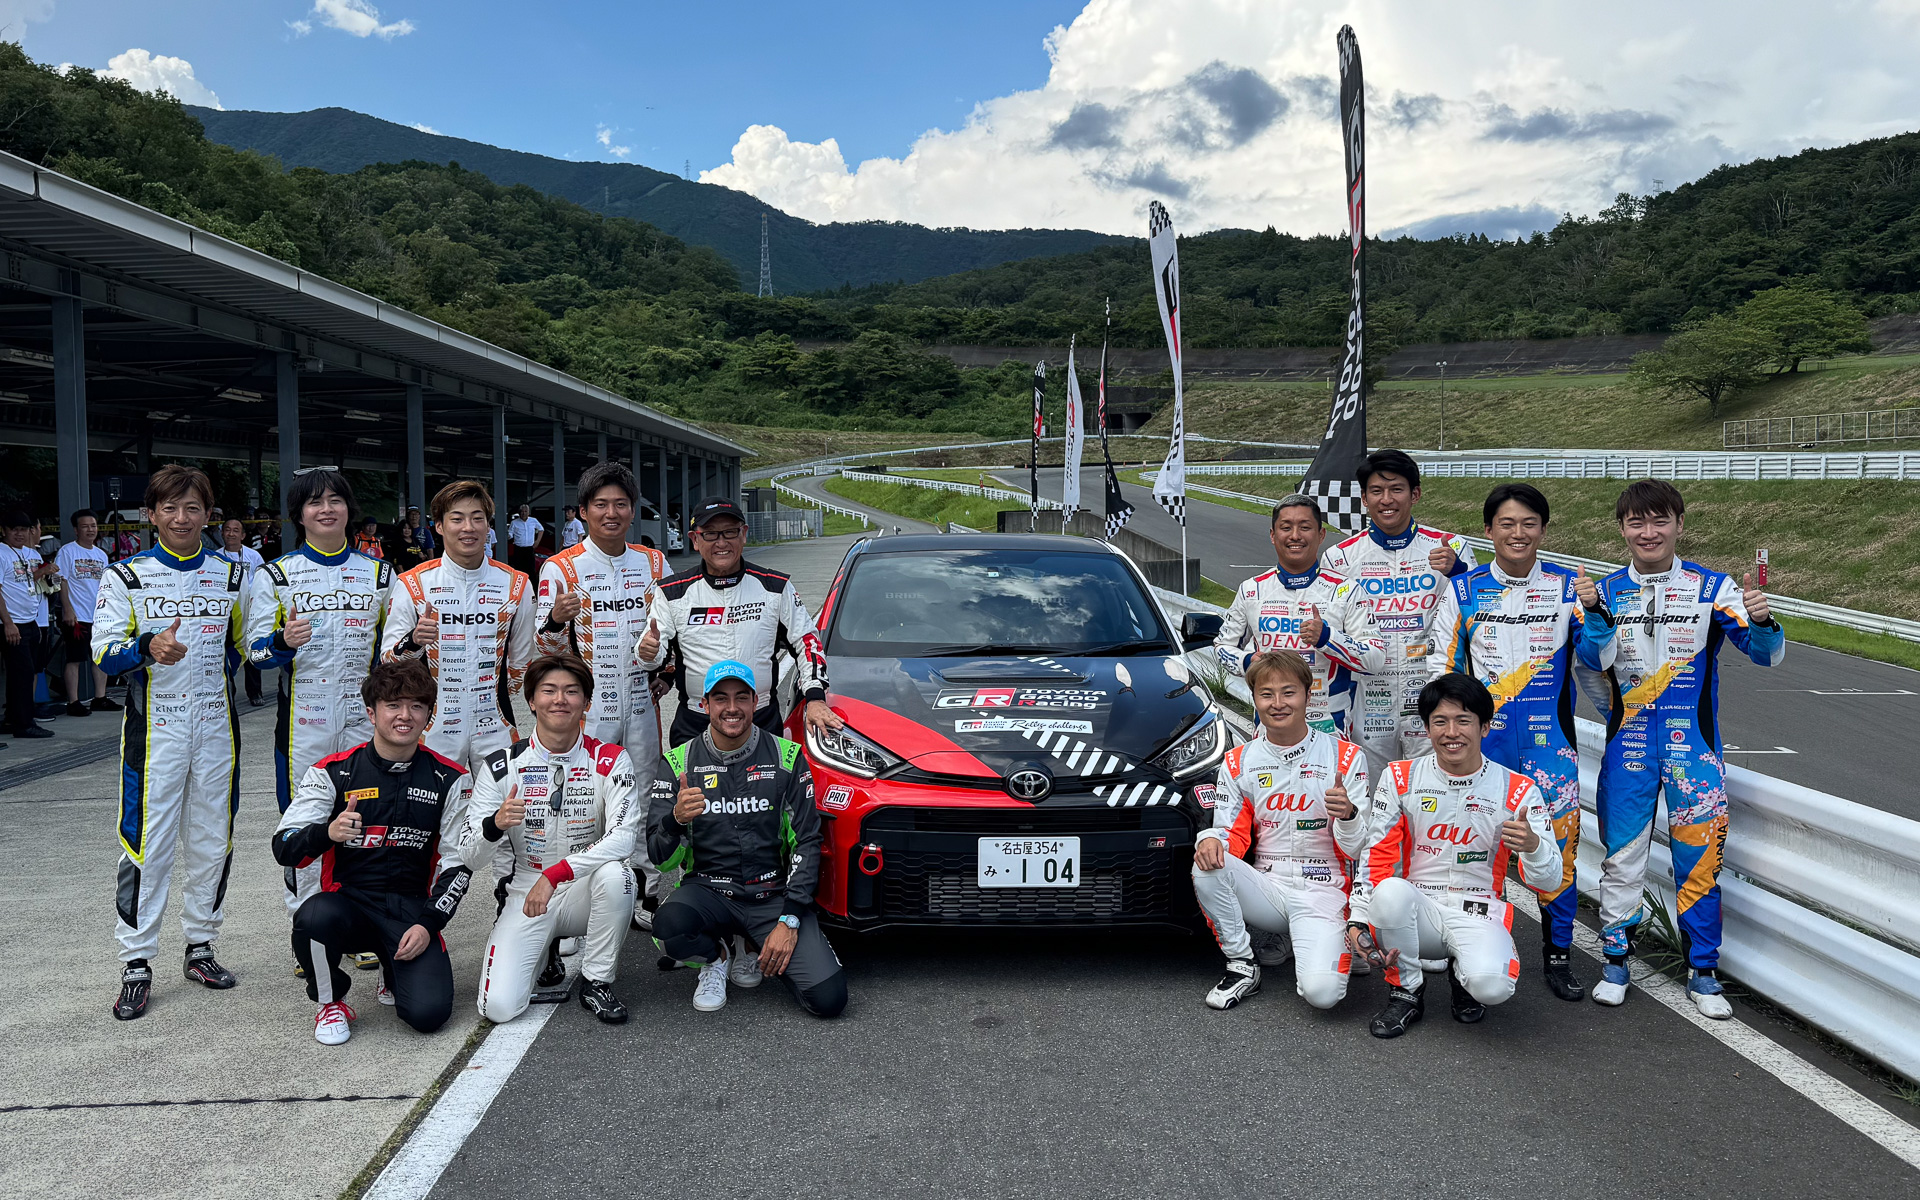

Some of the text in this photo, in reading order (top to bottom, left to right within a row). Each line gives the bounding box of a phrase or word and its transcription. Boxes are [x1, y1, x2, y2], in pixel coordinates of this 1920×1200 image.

[1456, 578, 1468, 601] sparco
[1703, 576, 1717, 599] sparco
[145, 596, 229, 618] KeePer
[293, 590, 373, 613] KeePer
[593, 596, 644, 612] ENEOS
[729, 602, 766, 611] TOYOTA
[442, 612, 496, 625] ENEOS
[728, 608, 762, 618] GAZOO
[344, 618, 368, 626] ZENT
[688, 614, 722, 626] GR
[726, 614, 761, 624] Racing
[202, 624, 224, 634] ZENT
[208, 700, 225, 710] FOX
[938, 694, 1011, 708] GR
[1018, 700, 1096, 710] Racing
[1284, 746, 1306, 761] TOM'S
[1342, 744, 1356, 767] HRX
[492, 758, 506, 772] G
[598, 756, 614, 767] R
[1392, 763, 1405, 786] HRX
[1448, 778, 1473, 786] TOM'S
[408, 787, 438, 801] RODIN
[524, 786, 548, 796] BBS
[1510, 780, 1528, 806] HRX
[406, 796, 438, 806] MOTORSPORT
[828, 792, 846, 803] PRO
[1266, 793, 1314, 812] au
[526, 808, 546, 817] NETZ
[574, 808, 586, 816] MIE
[392, 826, 432, 836] TOYOTA
[1427, 824, 1480, 846] au
[388, 833, 428, 842] GAZOO
[386, 840, 424, 850] Racing
[1416, 844, 1442, 857] ZENT
[760, 870, 777, 880] HRX
